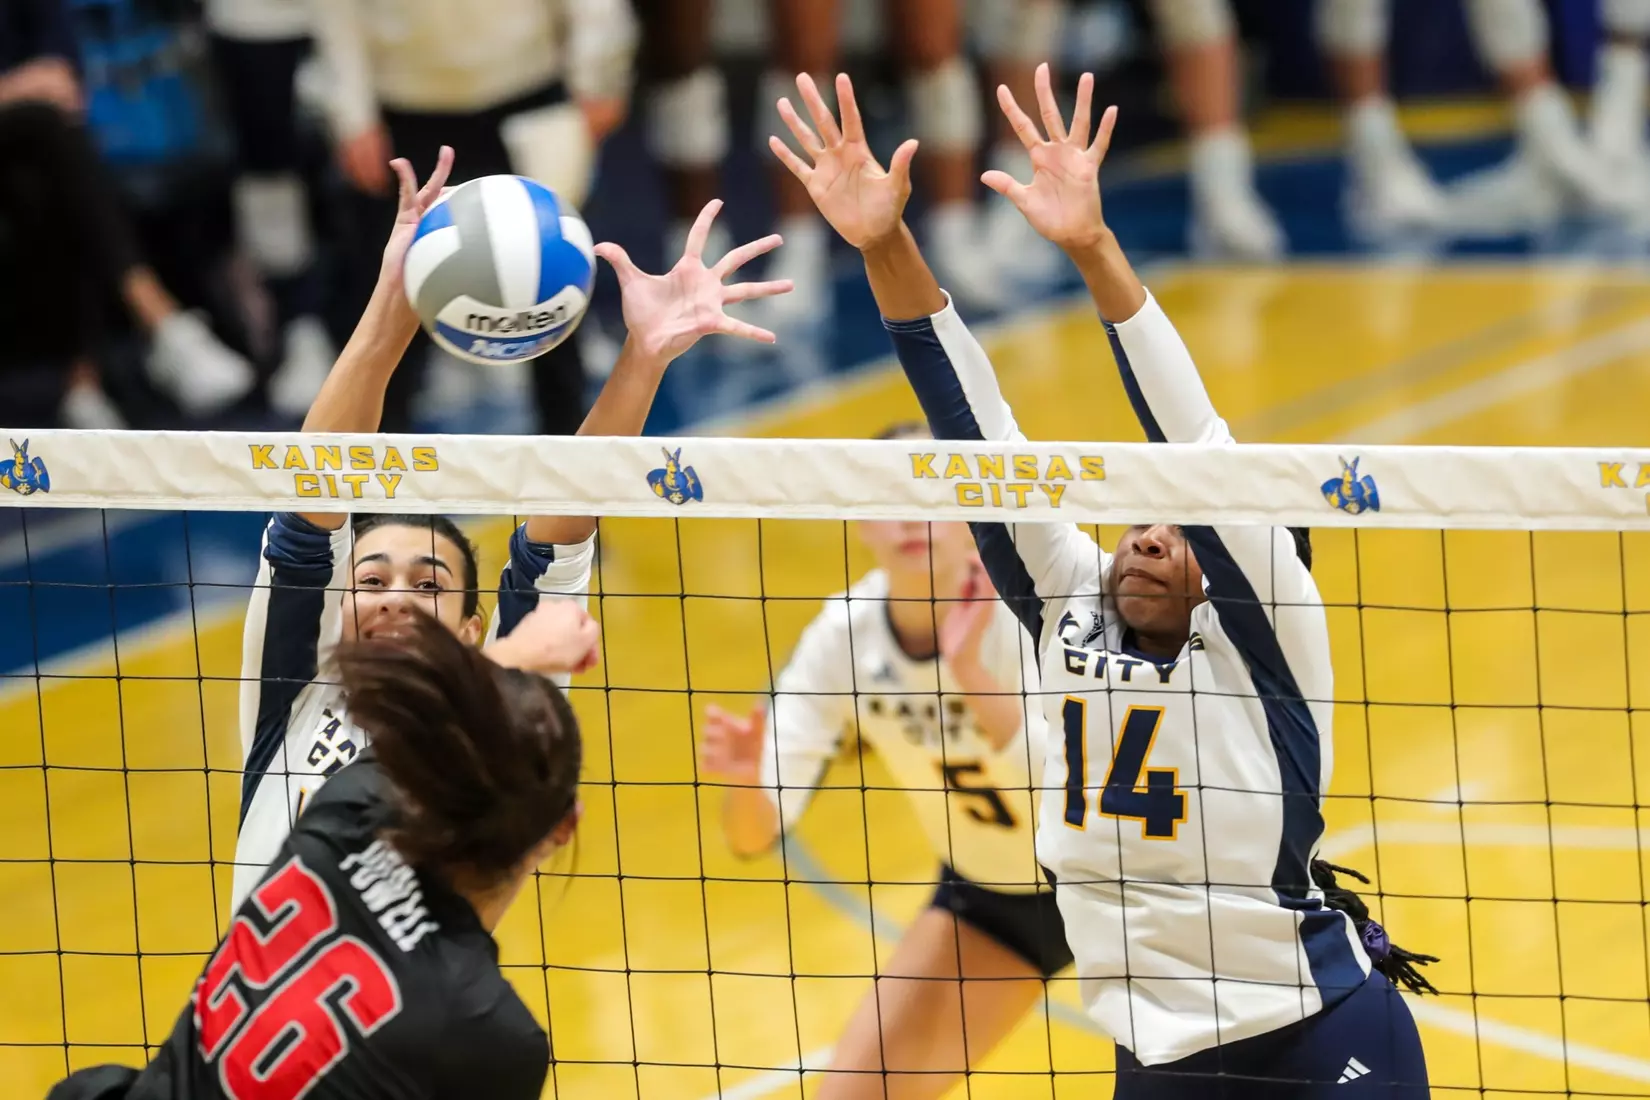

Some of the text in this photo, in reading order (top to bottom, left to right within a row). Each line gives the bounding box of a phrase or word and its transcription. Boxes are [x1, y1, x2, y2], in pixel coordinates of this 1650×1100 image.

[466, 304, 567, 333] molten
[248, 444, 440, 472] KANSAS
[908, 453, 1107, 481] KANSAS
[294, 473, 402, 499] CITY
[955, 482, 1067, 508] CITY
[1063, 648, 1180, 684] CITY
[1062, 694, 1189, 841] 14
[934, 760, 1020, 829] 5
[190, 855, 404, 1100] 26
